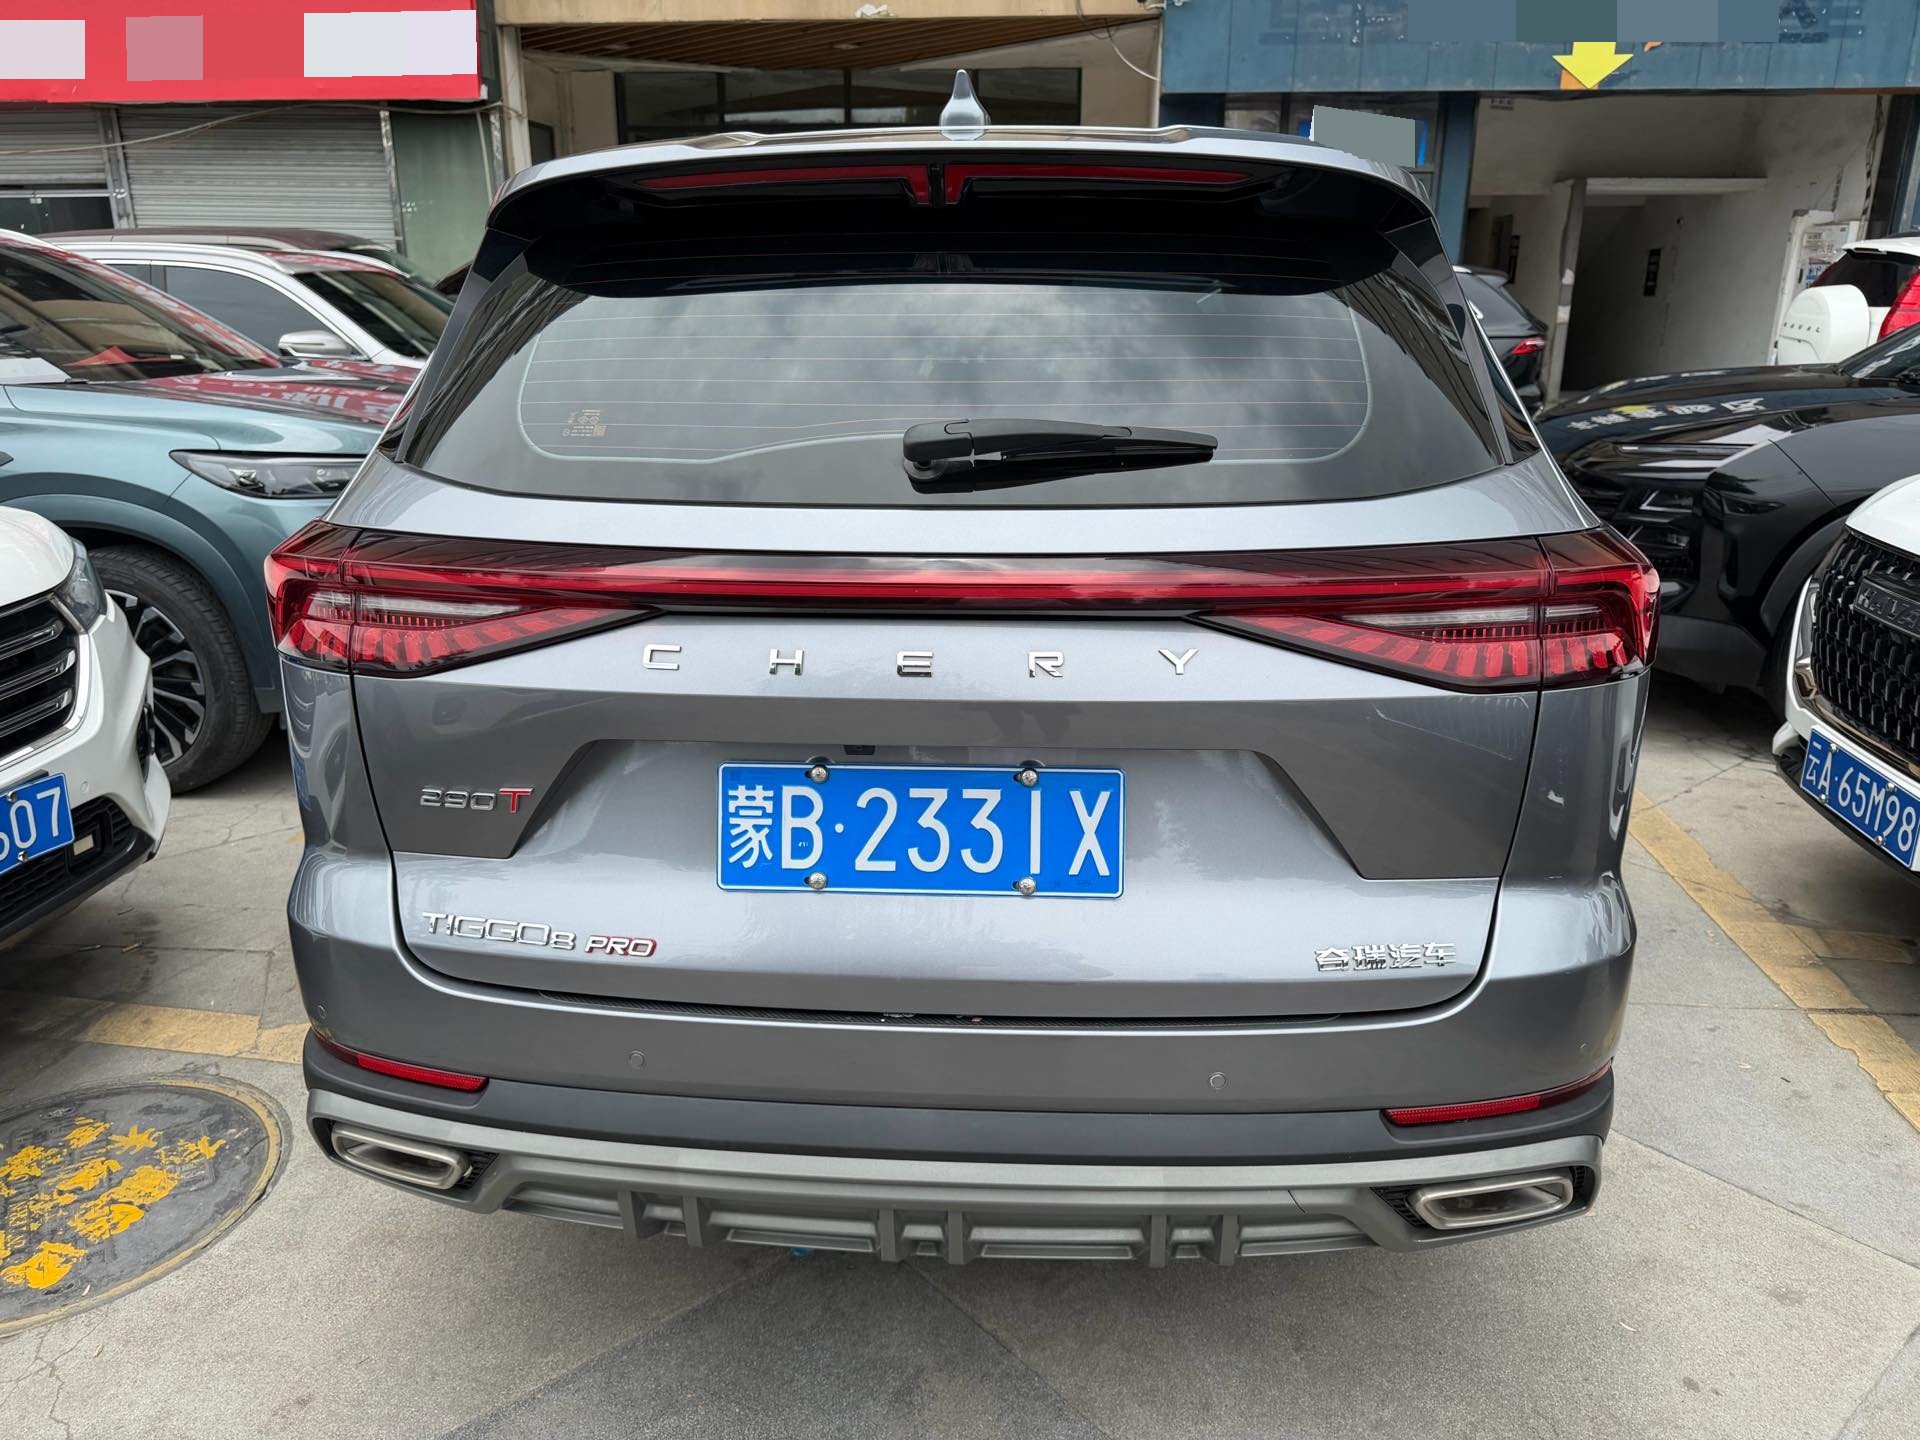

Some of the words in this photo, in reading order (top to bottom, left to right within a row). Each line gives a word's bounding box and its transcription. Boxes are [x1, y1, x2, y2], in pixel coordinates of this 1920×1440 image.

[642, 643, 1199, 678] CHERY
[419, 786, 534, 814] 290T
[584, 934, 657, 957] PRO
[1315, 942, 1457, 972] 奇瑞汽车
